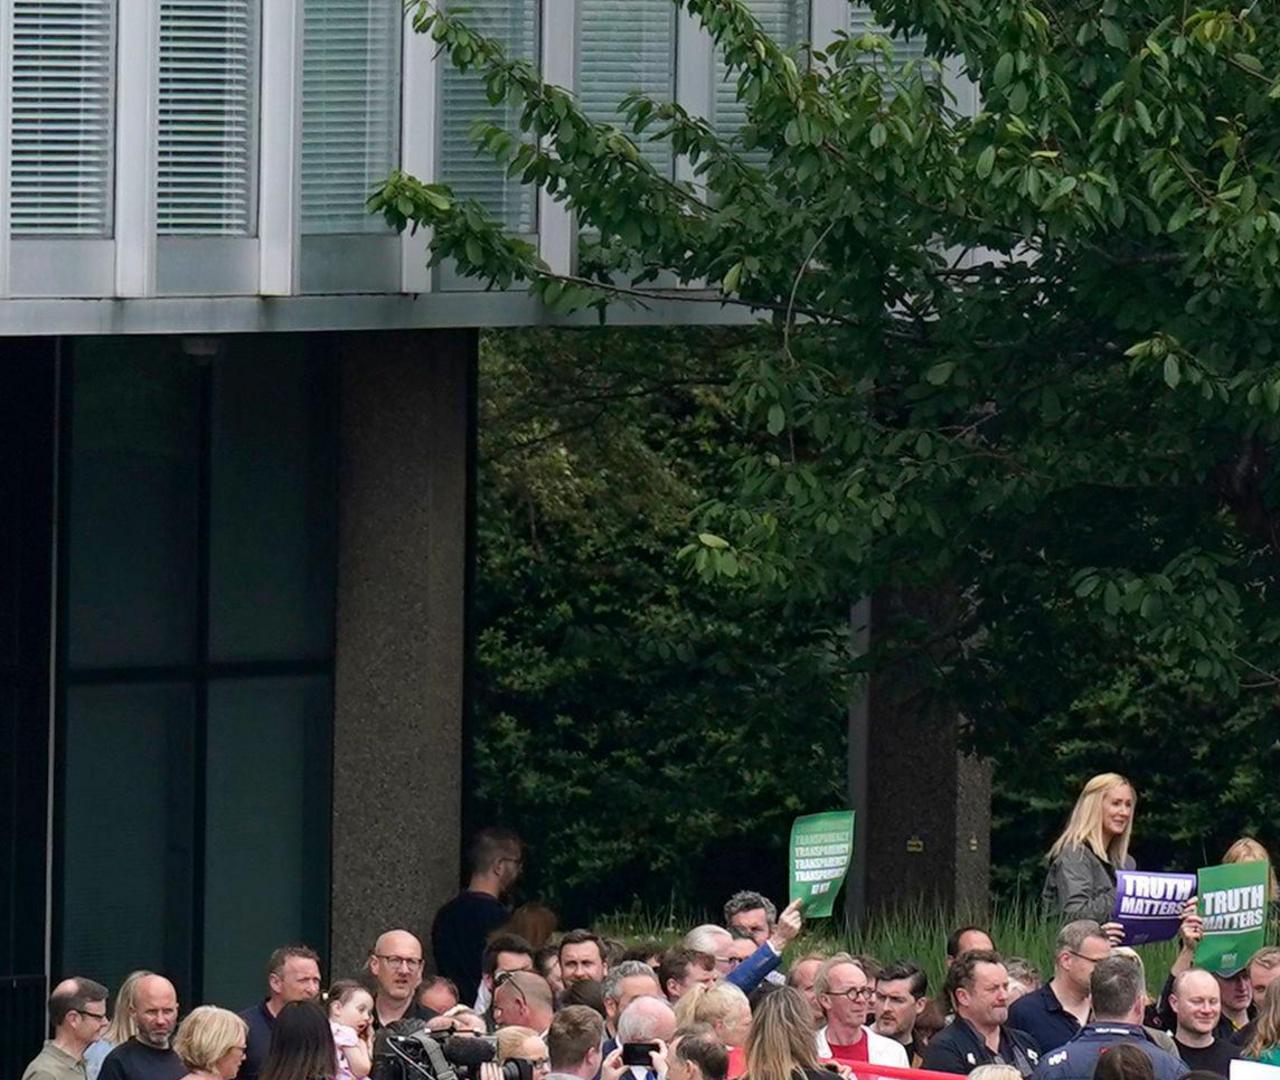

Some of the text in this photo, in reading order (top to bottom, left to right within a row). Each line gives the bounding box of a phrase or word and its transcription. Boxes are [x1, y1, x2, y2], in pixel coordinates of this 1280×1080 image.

[1122, 874, 1193, 901] TRUTH
[1203, 884, 1265, 915] TRUTH
[1120, 897, 1187, 916] MATTERS
